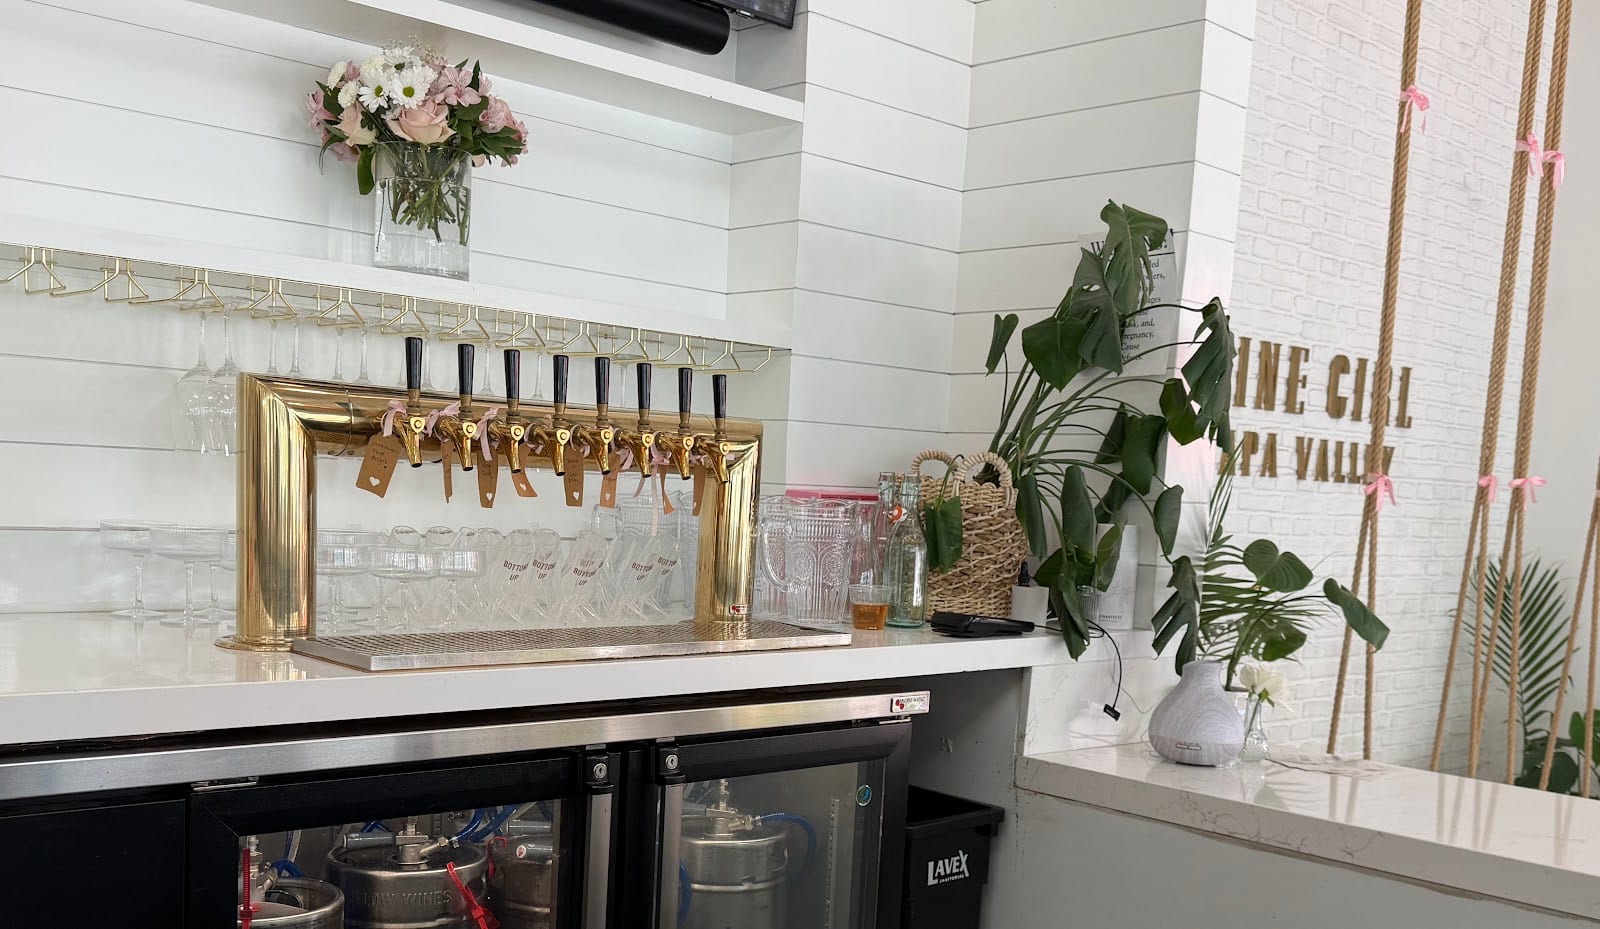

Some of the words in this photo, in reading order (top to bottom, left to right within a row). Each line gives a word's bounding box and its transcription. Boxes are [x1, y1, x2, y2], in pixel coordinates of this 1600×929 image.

[1123, 331, 1154, 340] regnancy,
[1233, 336, 1310, 415] INE
[1217, 429, 1278, 478] PA
[509, 573, 520, 581] UP
[927, 849, 970, 887] LAVEX
[402, 889, 453, 907] WINES
